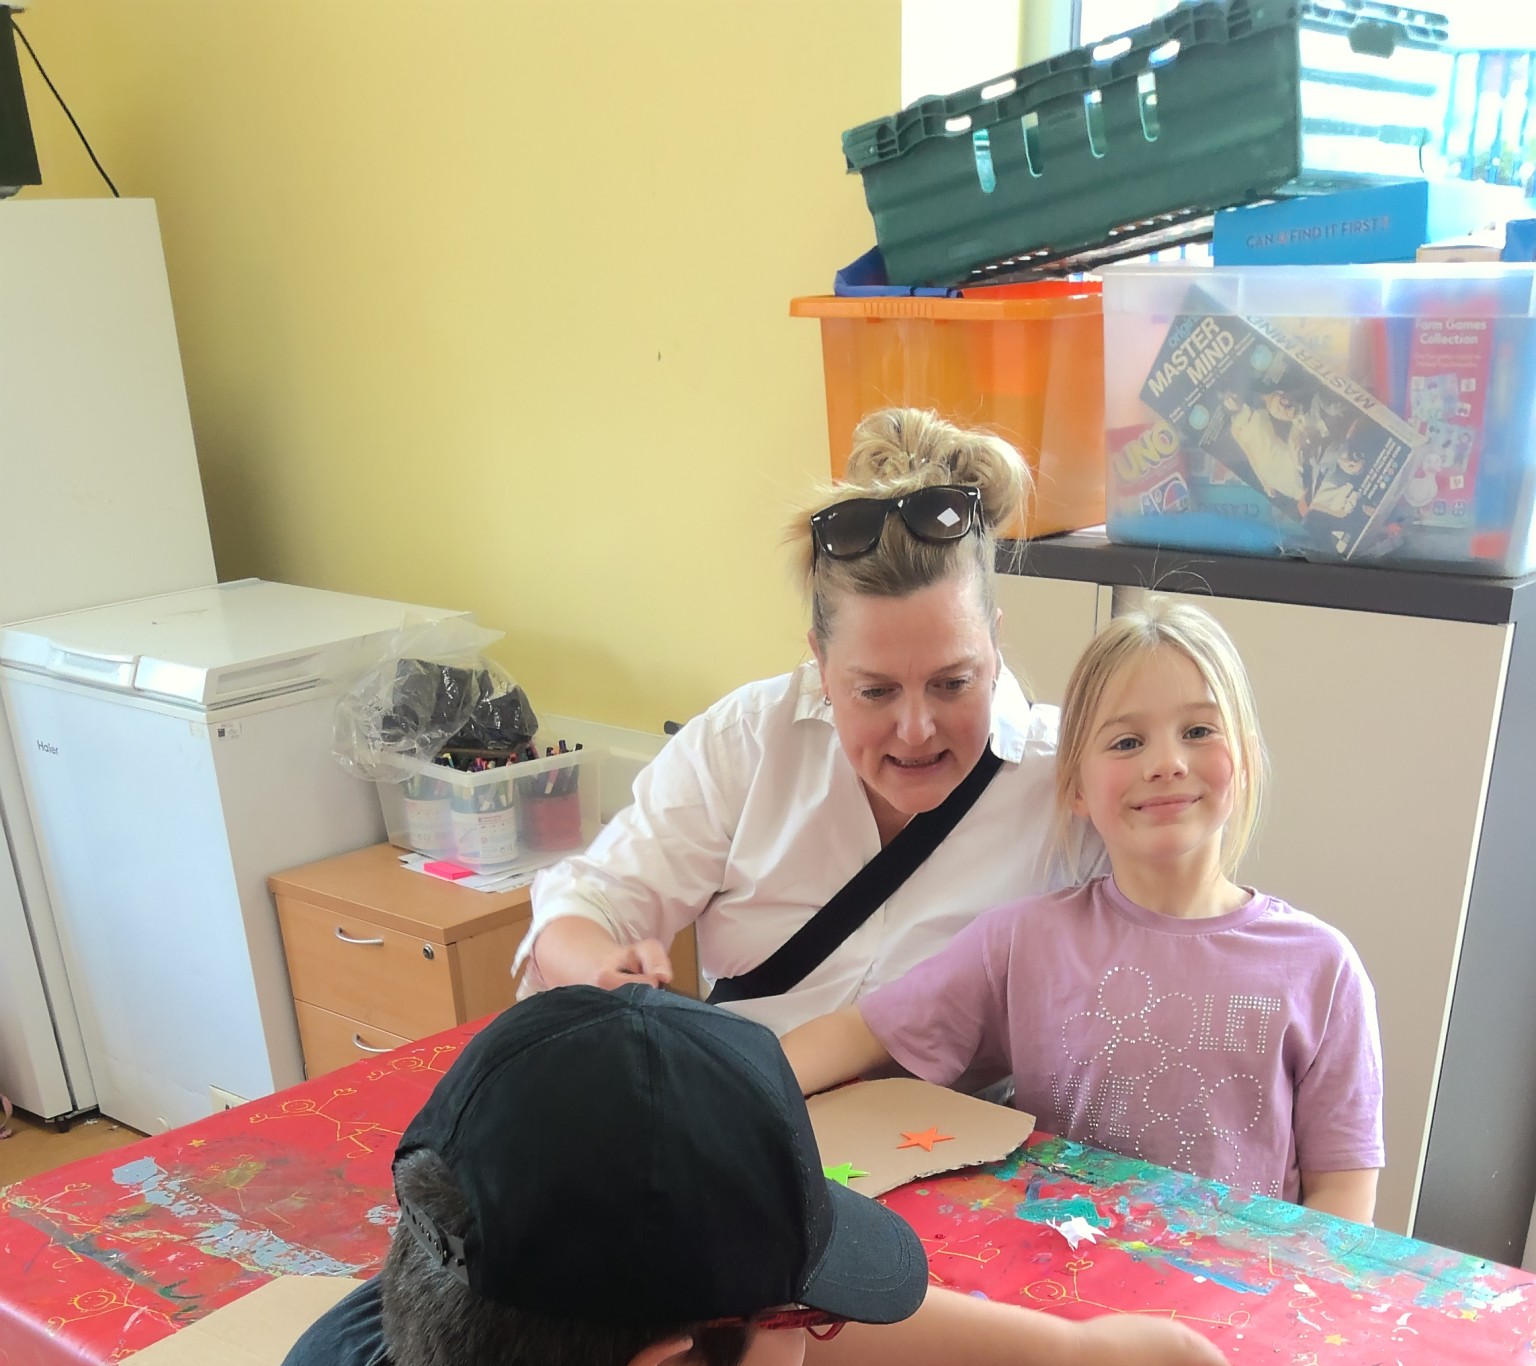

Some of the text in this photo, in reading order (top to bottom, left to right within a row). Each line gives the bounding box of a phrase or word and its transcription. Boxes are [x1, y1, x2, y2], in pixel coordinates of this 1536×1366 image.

[1246, 232, 1274, 248] CAN
[1290, 226, 1322, 243] FIND
[1325, 223, 1338, 239] IT
[1446, 319, 1488, 331] Games
[1420, 332, 1479, 345] Collection
[1147, 316, 1220, 398] MASTER
[1186, 331, 1235, 386] MIND
[1112, 420, 1180, 481] UNO
[36, 739, 59, 756] Haier
